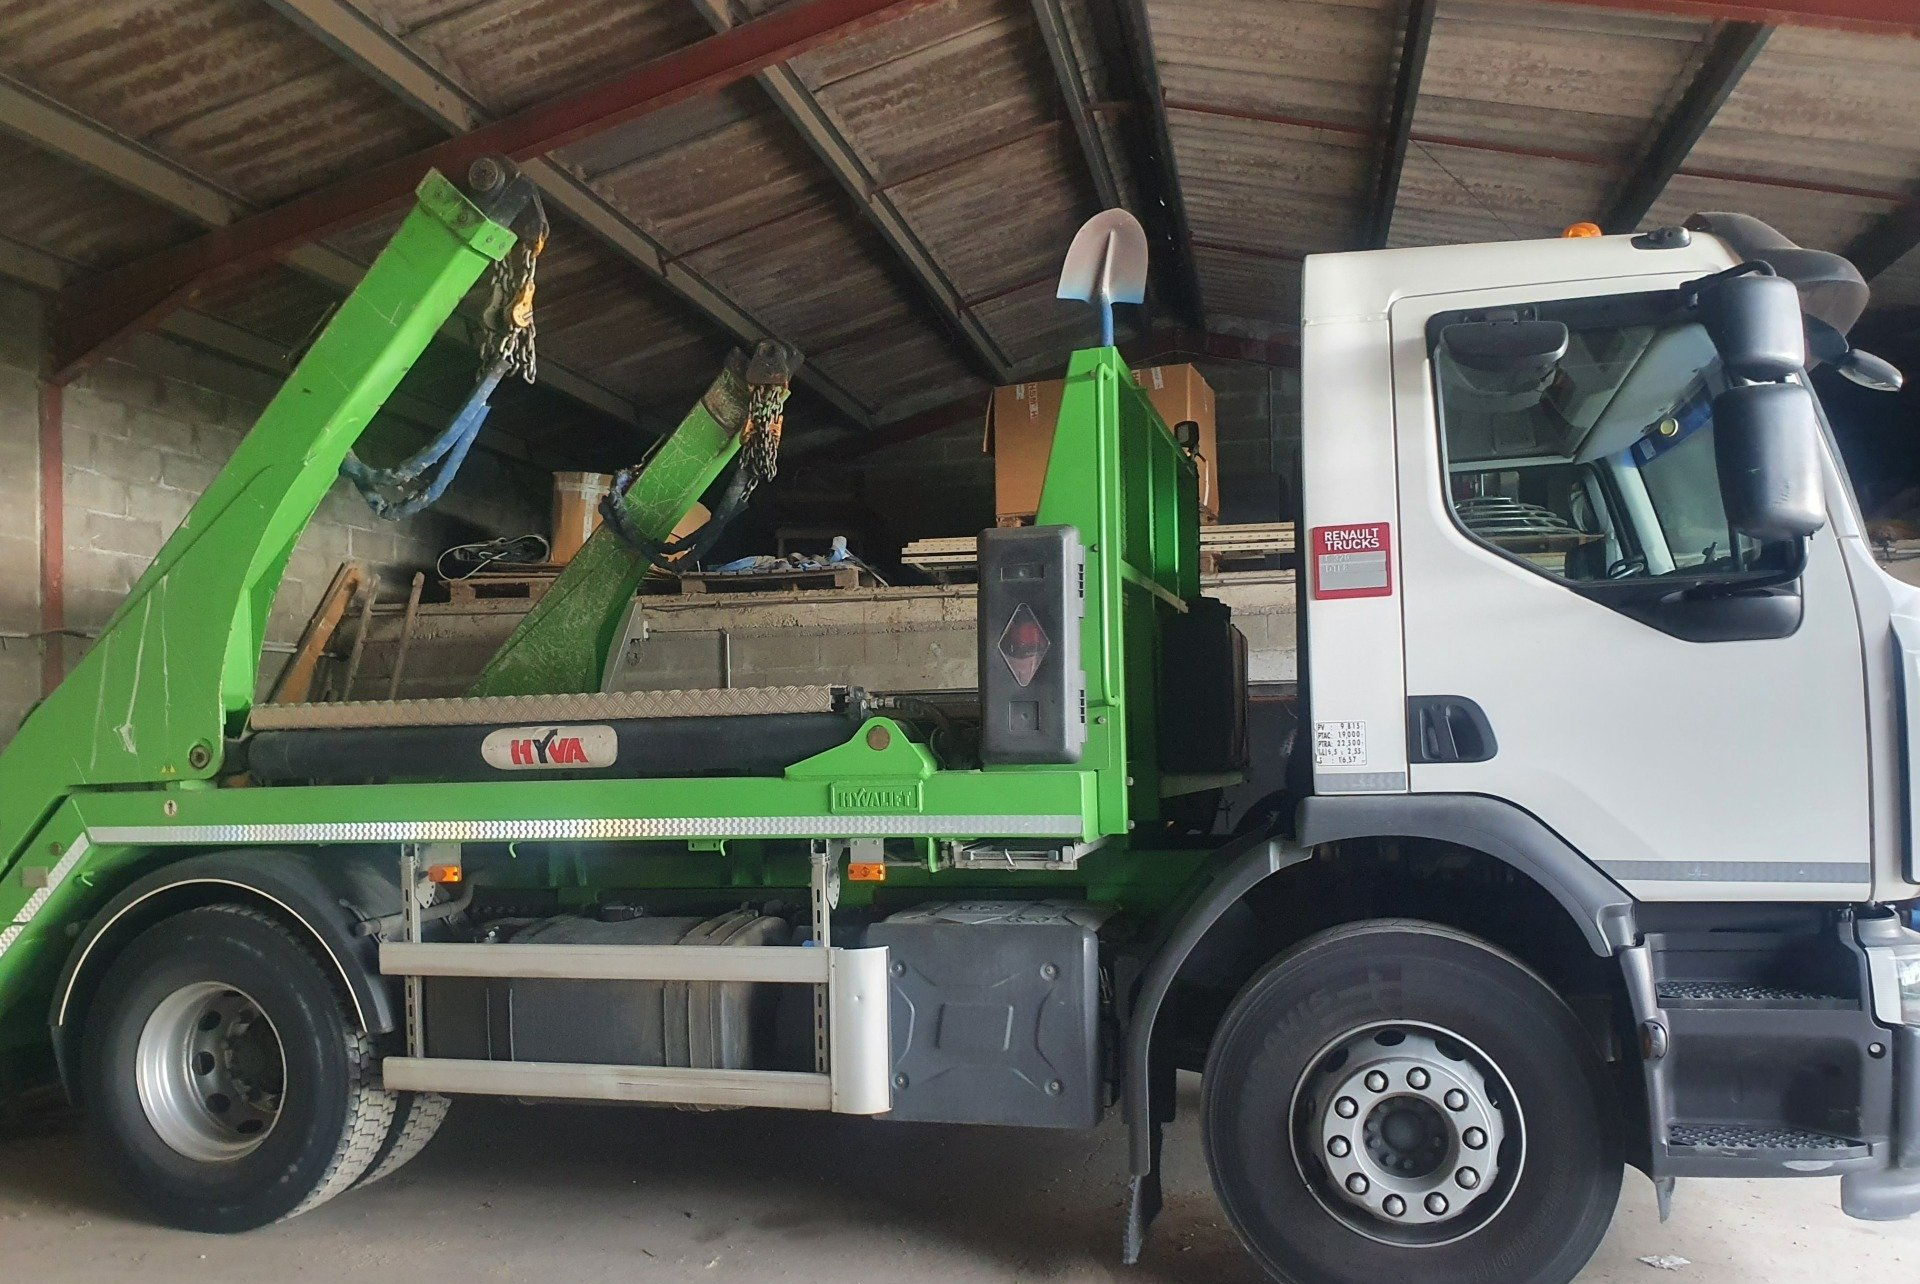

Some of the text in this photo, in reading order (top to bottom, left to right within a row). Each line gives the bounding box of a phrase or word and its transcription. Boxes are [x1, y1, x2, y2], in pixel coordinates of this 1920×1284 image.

[1324, 528, 1379, 541] RENAULT
[1325, 538, 1380, 551] TRUCKS
[510, 729, 589, 765] HYVA
[839, 788, 912, 807] HYVALIFT
